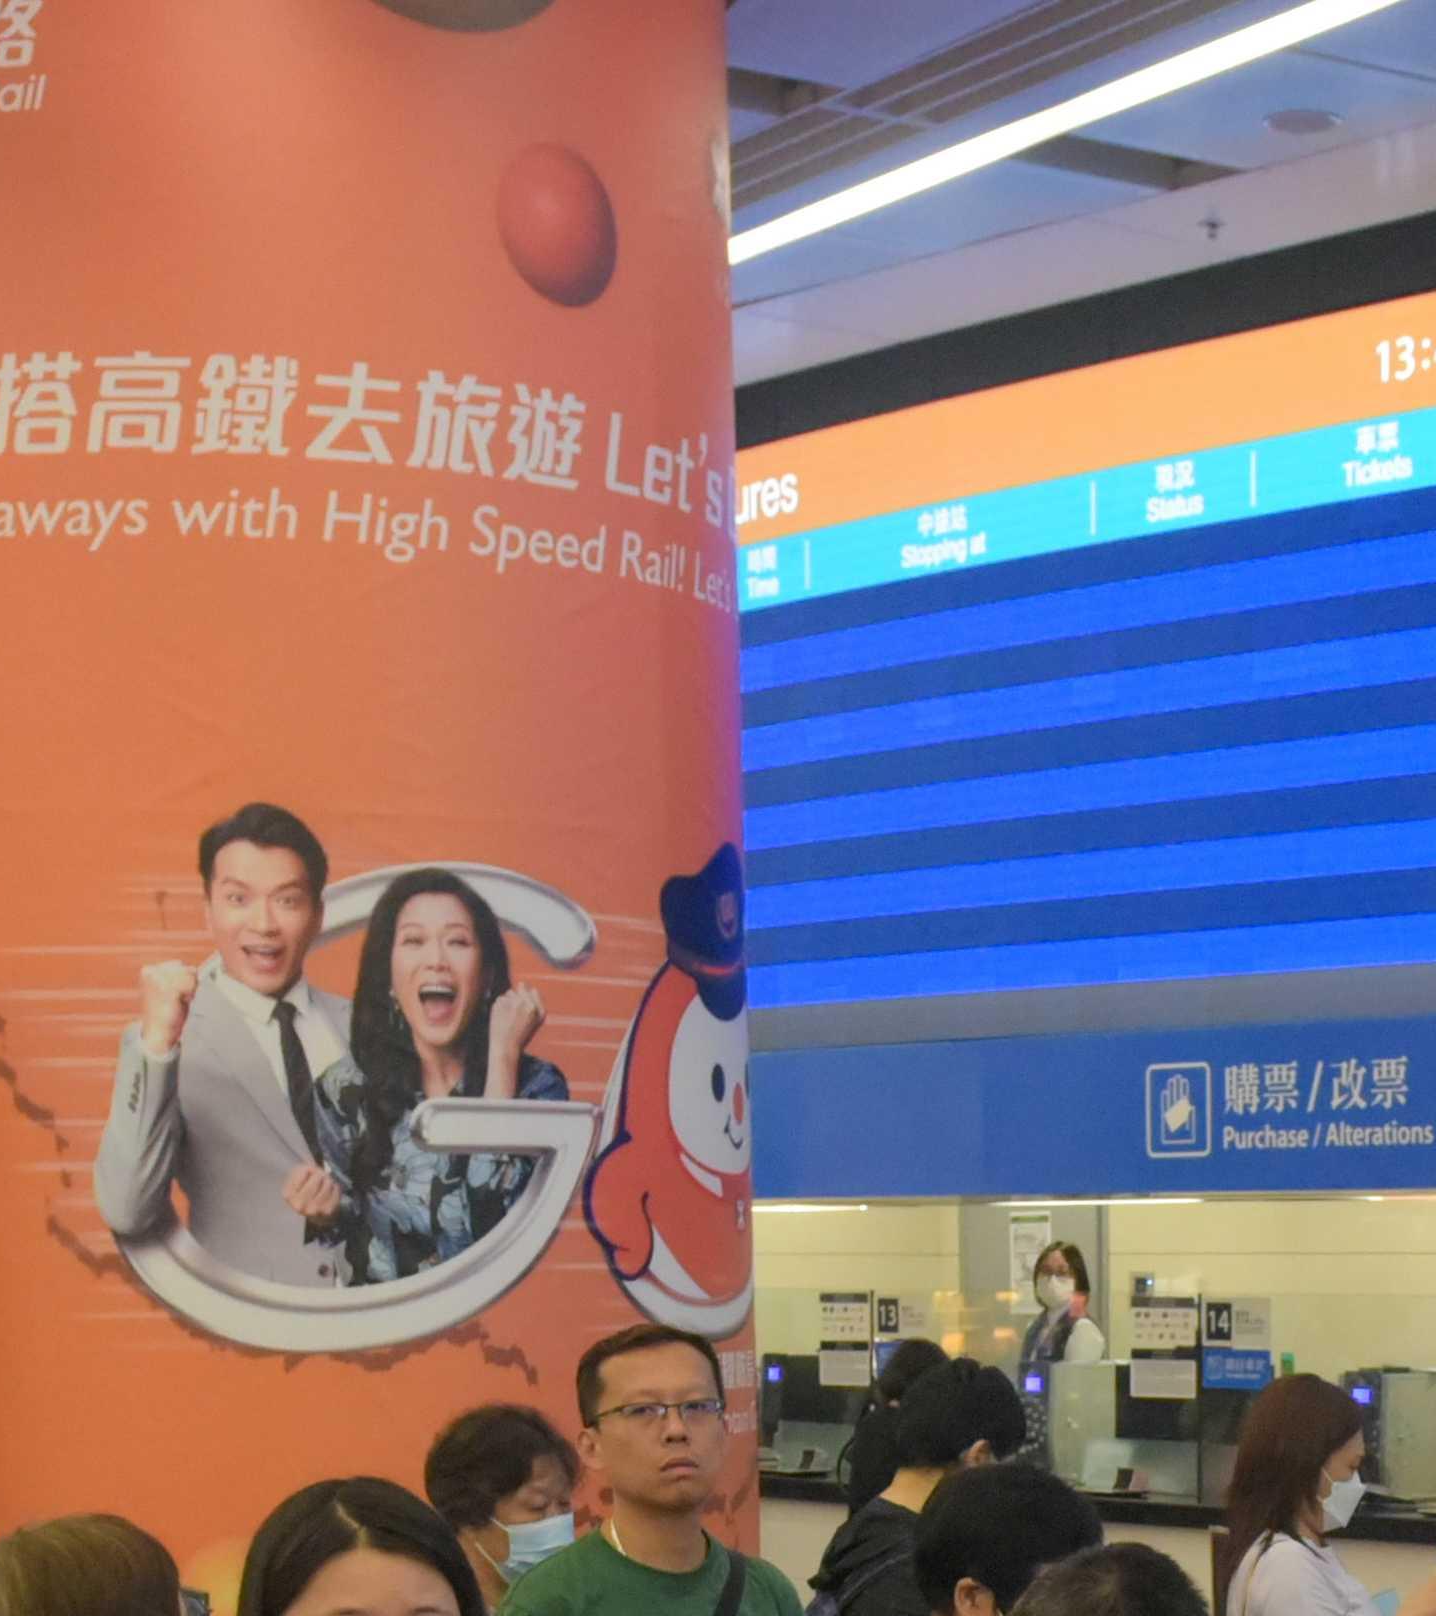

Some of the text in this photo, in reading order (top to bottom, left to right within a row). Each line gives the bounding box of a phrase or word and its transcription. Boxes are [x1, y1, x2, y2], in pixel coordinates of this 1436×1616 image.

[605, 410, 724, 528] Let's
[1341, 453, 1414, 488] Tickets
[1145, 492, 1205, 524] Status
[173, 485, 299, 541] with
[322, 490, 451, 563] High
[469, 506, 607, 577] Speed
[619, 528, 686, 592] Rail!
[1221, 1122, 1309, 1151] Purchase
[1324, 1120, 1435, 1148] Alterations
[879, 1304, 897, 1327] 13
[1208, 1309, 1231, 1333] 14
